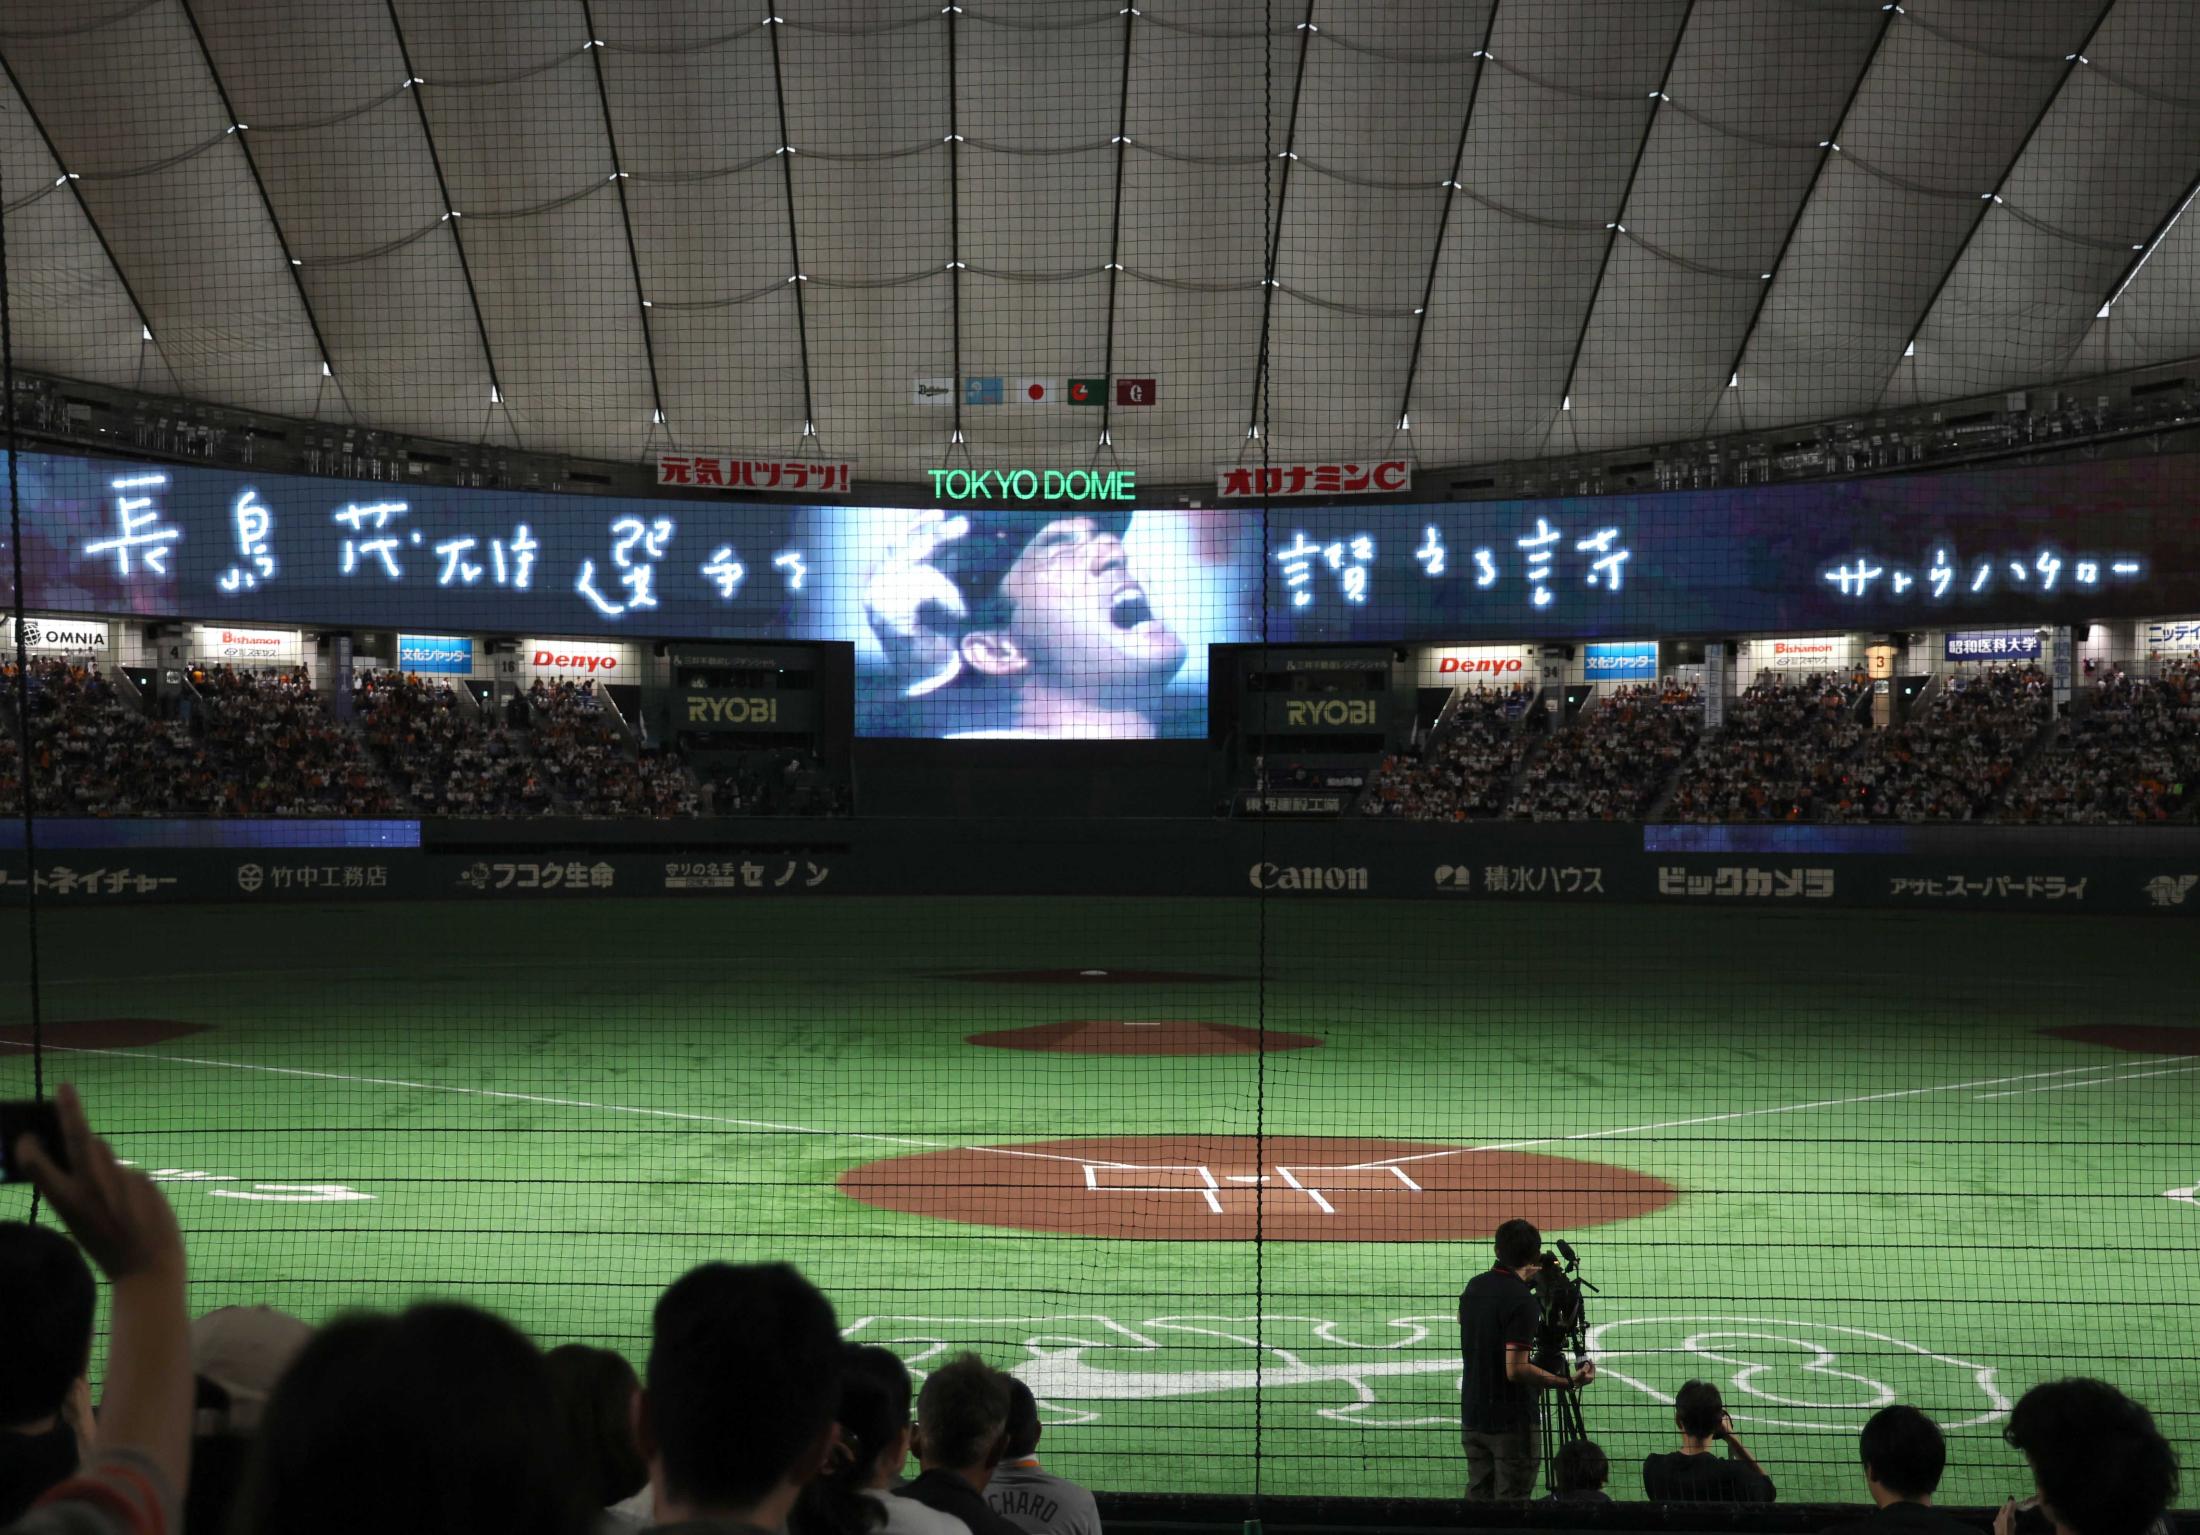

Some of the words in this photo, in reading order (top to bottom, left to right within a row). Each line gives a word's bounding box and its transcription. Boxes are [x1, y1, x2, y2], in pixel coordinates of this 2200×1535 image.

[661, 456, 848, 491] 元気ハツラツ!
[1223, 461, 1406, 495] オロナミンC
[928, 469, 1039, 501] TOKYO
[1043, 470, 1137, 502] DOME
[46, 631, 105, 645] OMNIA
[223, 632, 281, 645] Bishamon
[1775, 642, 1833, 654] Bishamon
[1948, 636, 2038, 654] 昭和医科大学
[401, 647, 471, 662] 文化シャッター
[533, 650, 618, 673] Denyo
[1586, 655, 1655, 670] 文化シャッター
[1876, 656, 1885, 668] 3
[501, 660, 516, 673] 16
[1439, 658, 1523, 677] Denyo
[1543, 665, 1558, 679] 34
[687, 695, 777, 724] RYOBI
[1286, 699, 1377, 726] RYOBI
[0, 866, 177, 895] ートネイチャー
[271, 866, 388, 888] 竹中工務店
[493, 862, 616, 889] フコク生命
[740, 861, 830, 888] セノン
[1249, 862, 1369, 891] Canon
[1484, 865, 1605, 893] 積水ハウス
[1658, 866, 1835, 898] ビックカメラ
